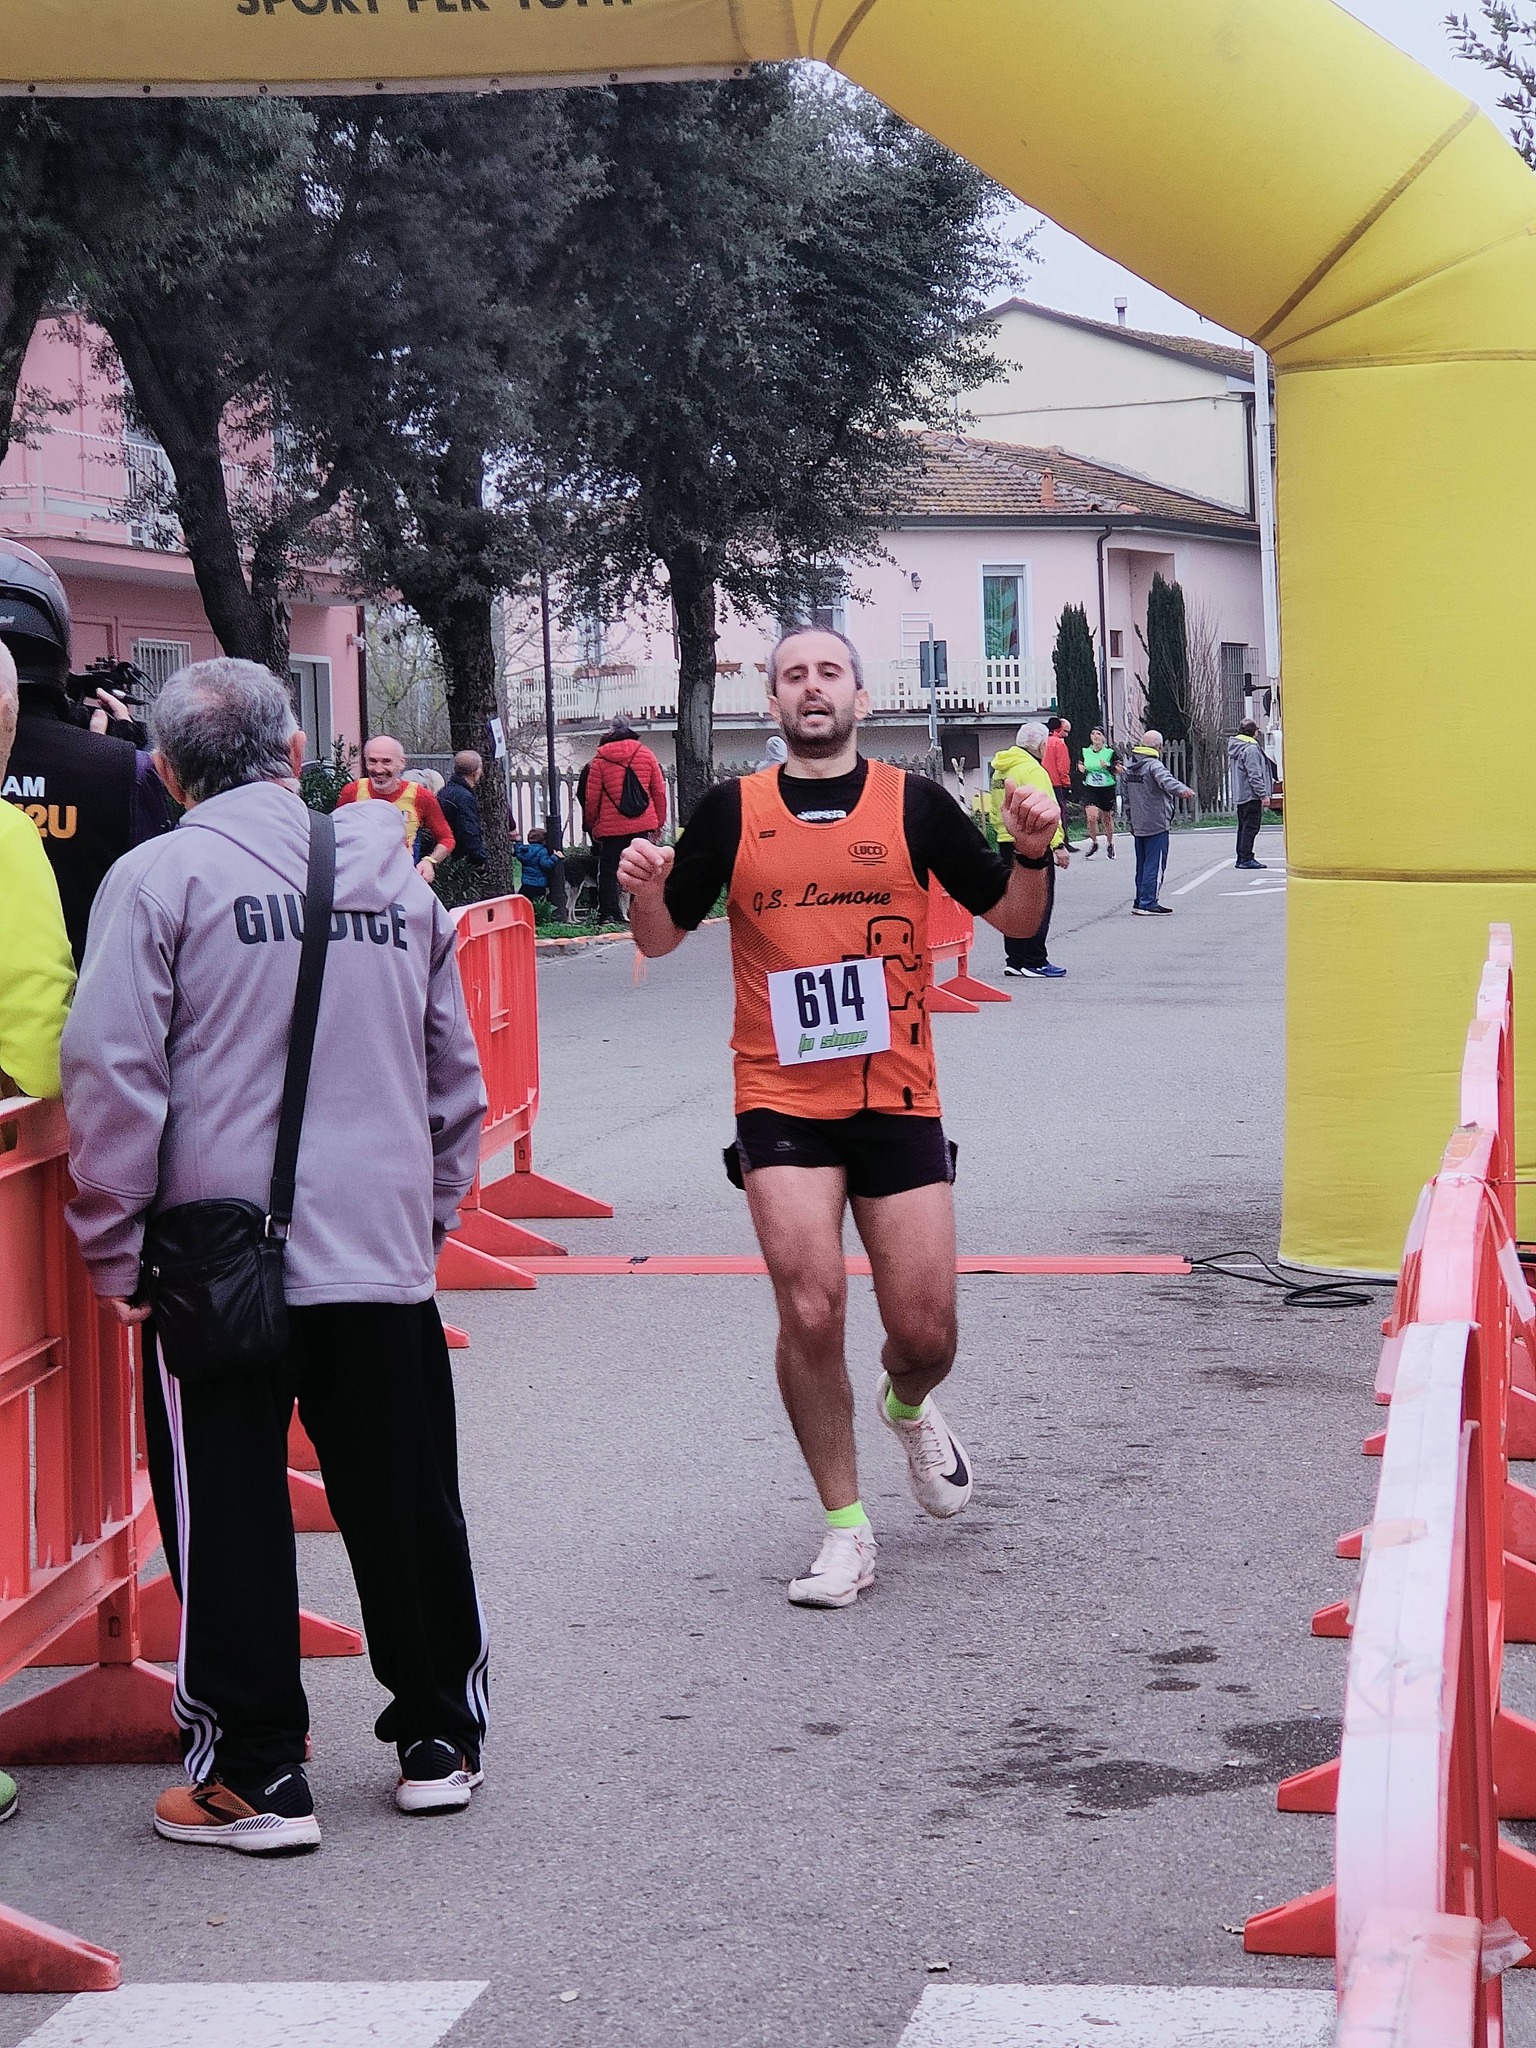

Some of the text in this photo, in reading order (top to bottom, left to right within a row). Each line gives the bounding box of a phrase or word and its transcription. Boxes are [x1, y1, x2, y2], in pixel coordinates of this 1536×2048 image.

[853, 845, 883, 856] LUCCI
[795, 882, 892, 907] Lamone
[794, 965, 865, 1029] 614
